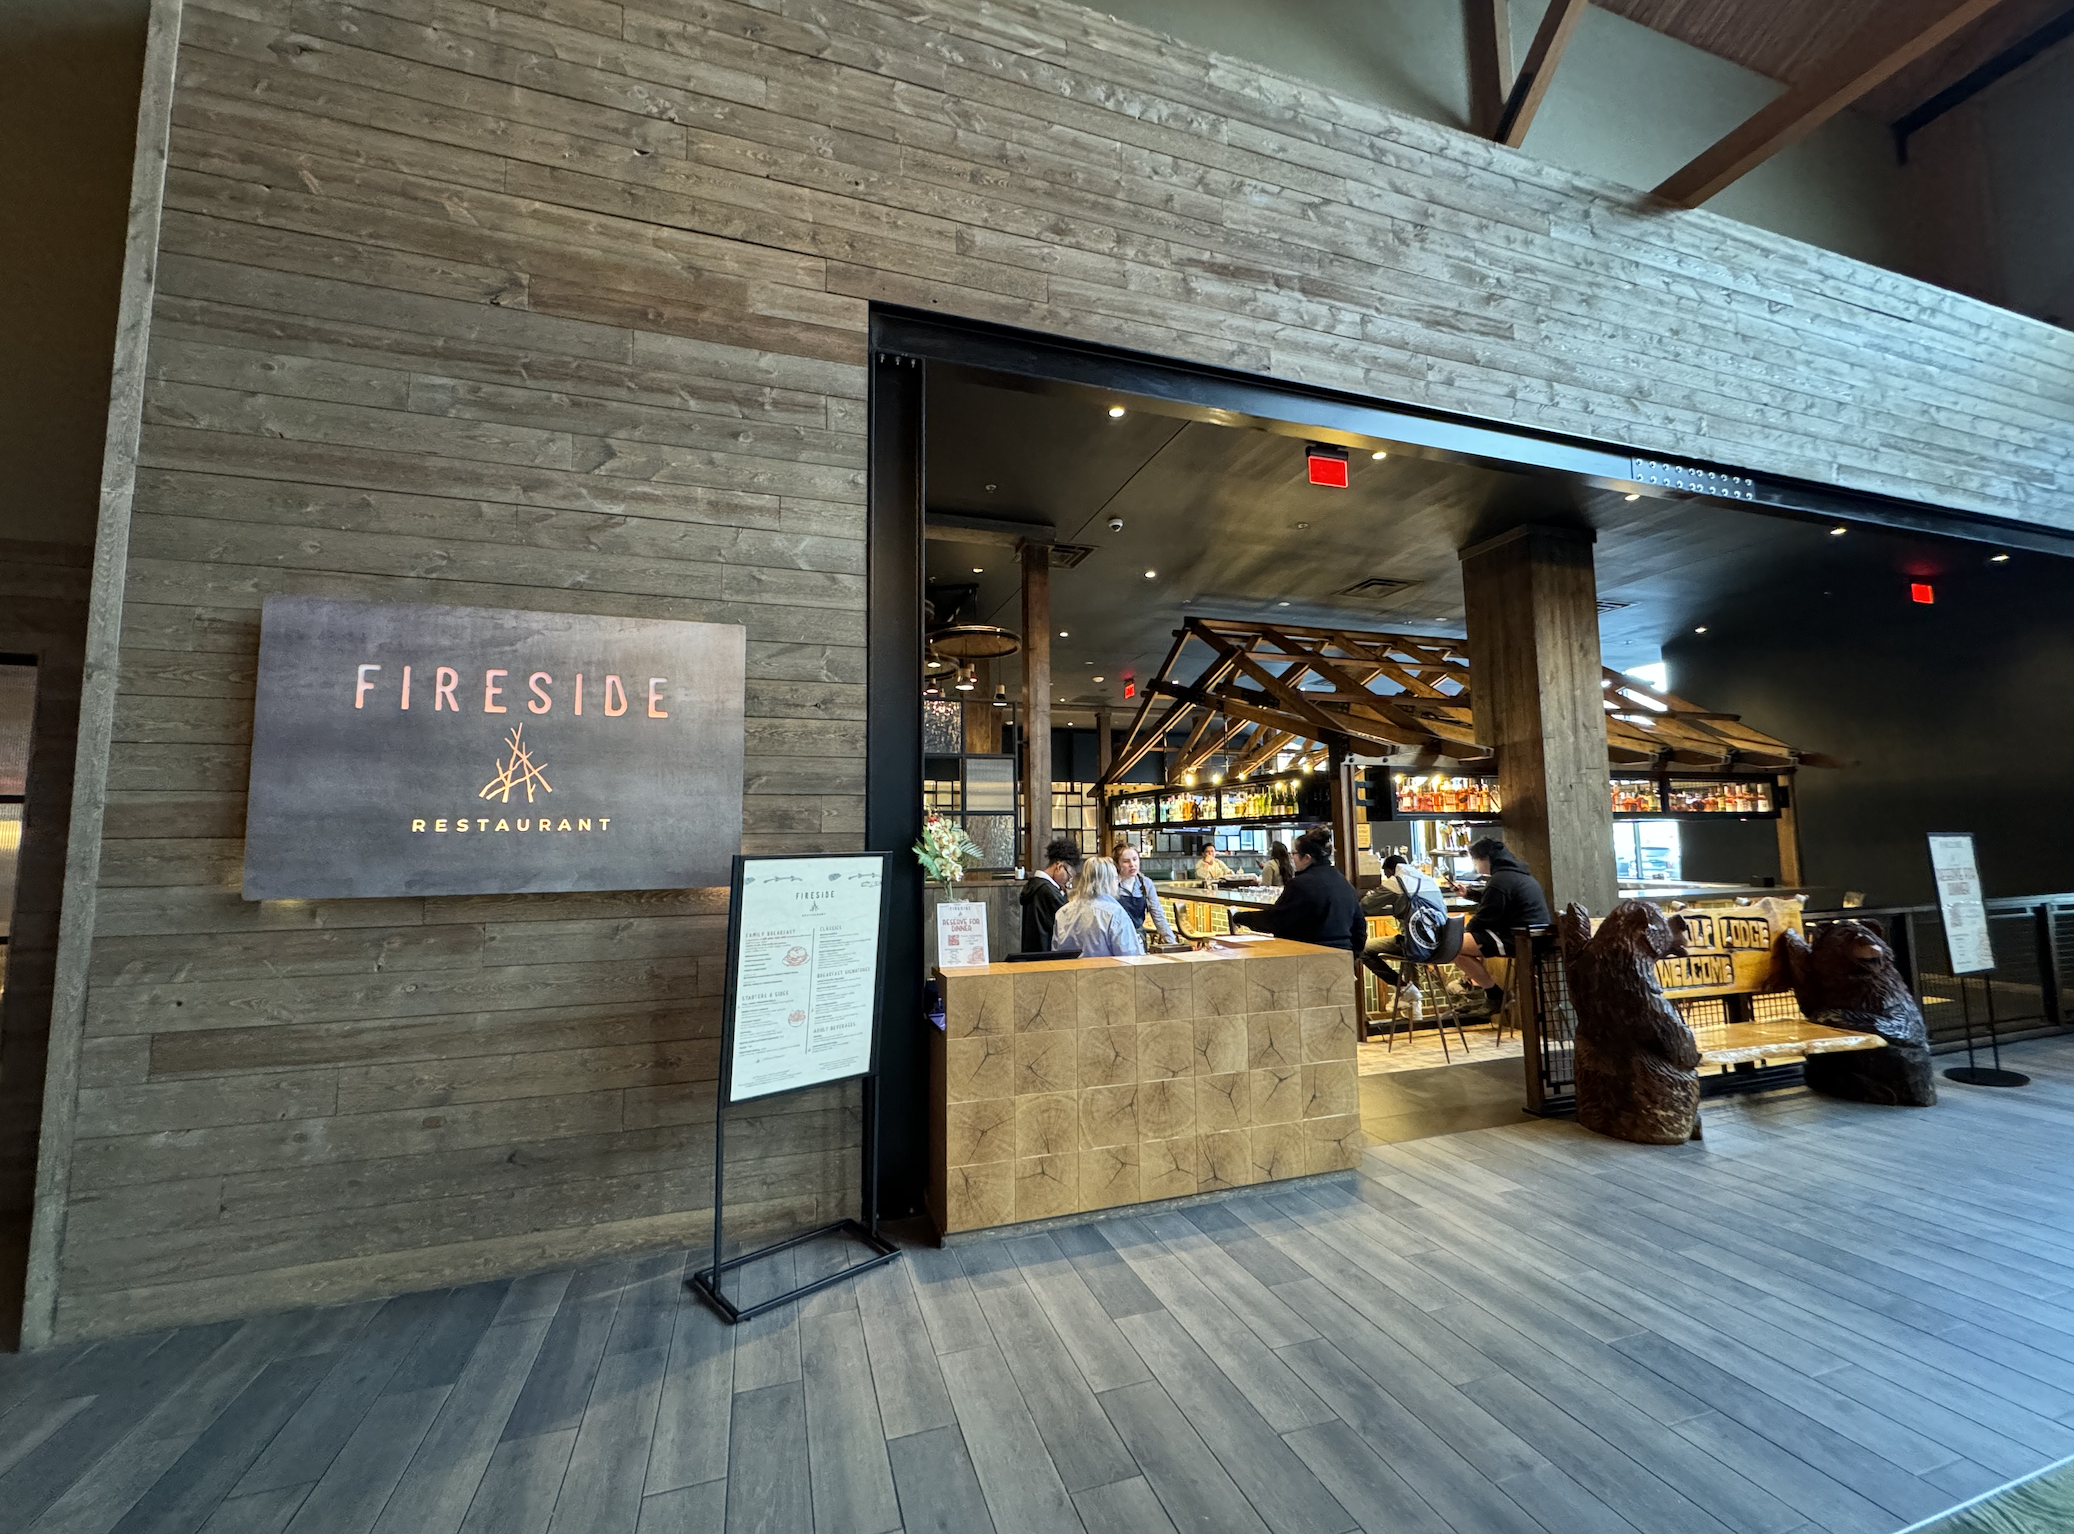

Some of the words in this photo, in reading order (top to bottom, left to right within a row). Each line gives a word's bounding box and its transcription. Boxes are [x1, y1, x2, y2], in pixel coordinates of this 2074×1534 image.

[354, 664, 669, 718] FIRESIDE
[411, 818, 612, 833] RESTAURANT
[796, 891, 835, 900] FIRESIDE
[942, 918, 967, 926] RESERVE
[1683, 919, 1714, 946] OLF
[1719, 918, 1769, 949] LODGE
[1654, 956, 1733, 987] WELCOME
